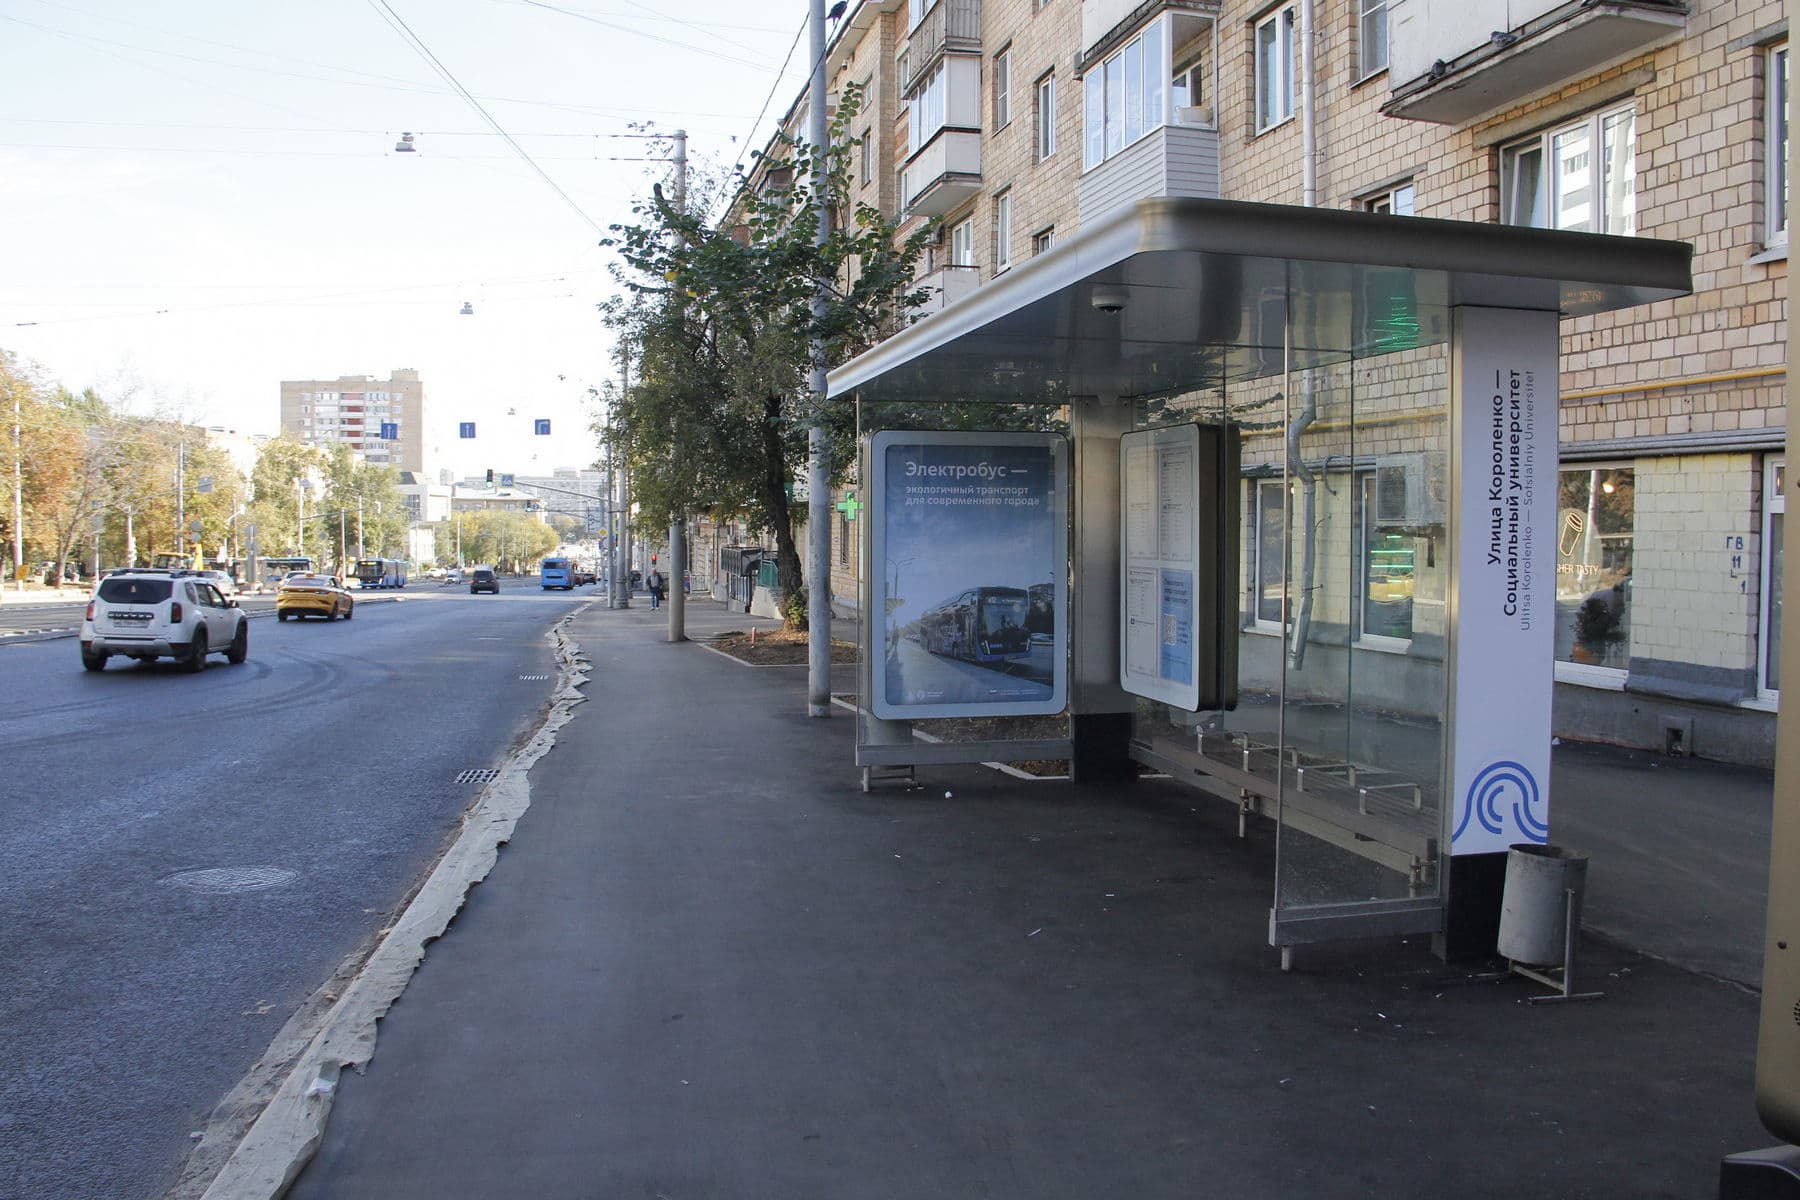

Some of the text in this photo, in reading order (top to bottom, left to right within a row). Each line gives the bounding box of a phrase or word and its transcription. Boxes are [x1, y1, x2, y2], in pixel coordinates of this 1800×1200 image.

[1524, 371, 1535, 440] Universitet
[905, 461, 1006, 480] Электробус
[1489, 395, 1505, 500] Короленко
[1523, 444, 1535, 506] Sotsialniy
[905, 485, 1029, 496] экологичный транспорт
[905, 496, 1039, 507] для современного города
[1504, 369, 1522, 616] Социальный университет
[1488, 507, 1504, 565] Улица
[1522, 527, 1532, 590] Korolenko
[1575, 564, 1599, 576] TASTY
[1521, 594, 1531, 630] Ulitsa
